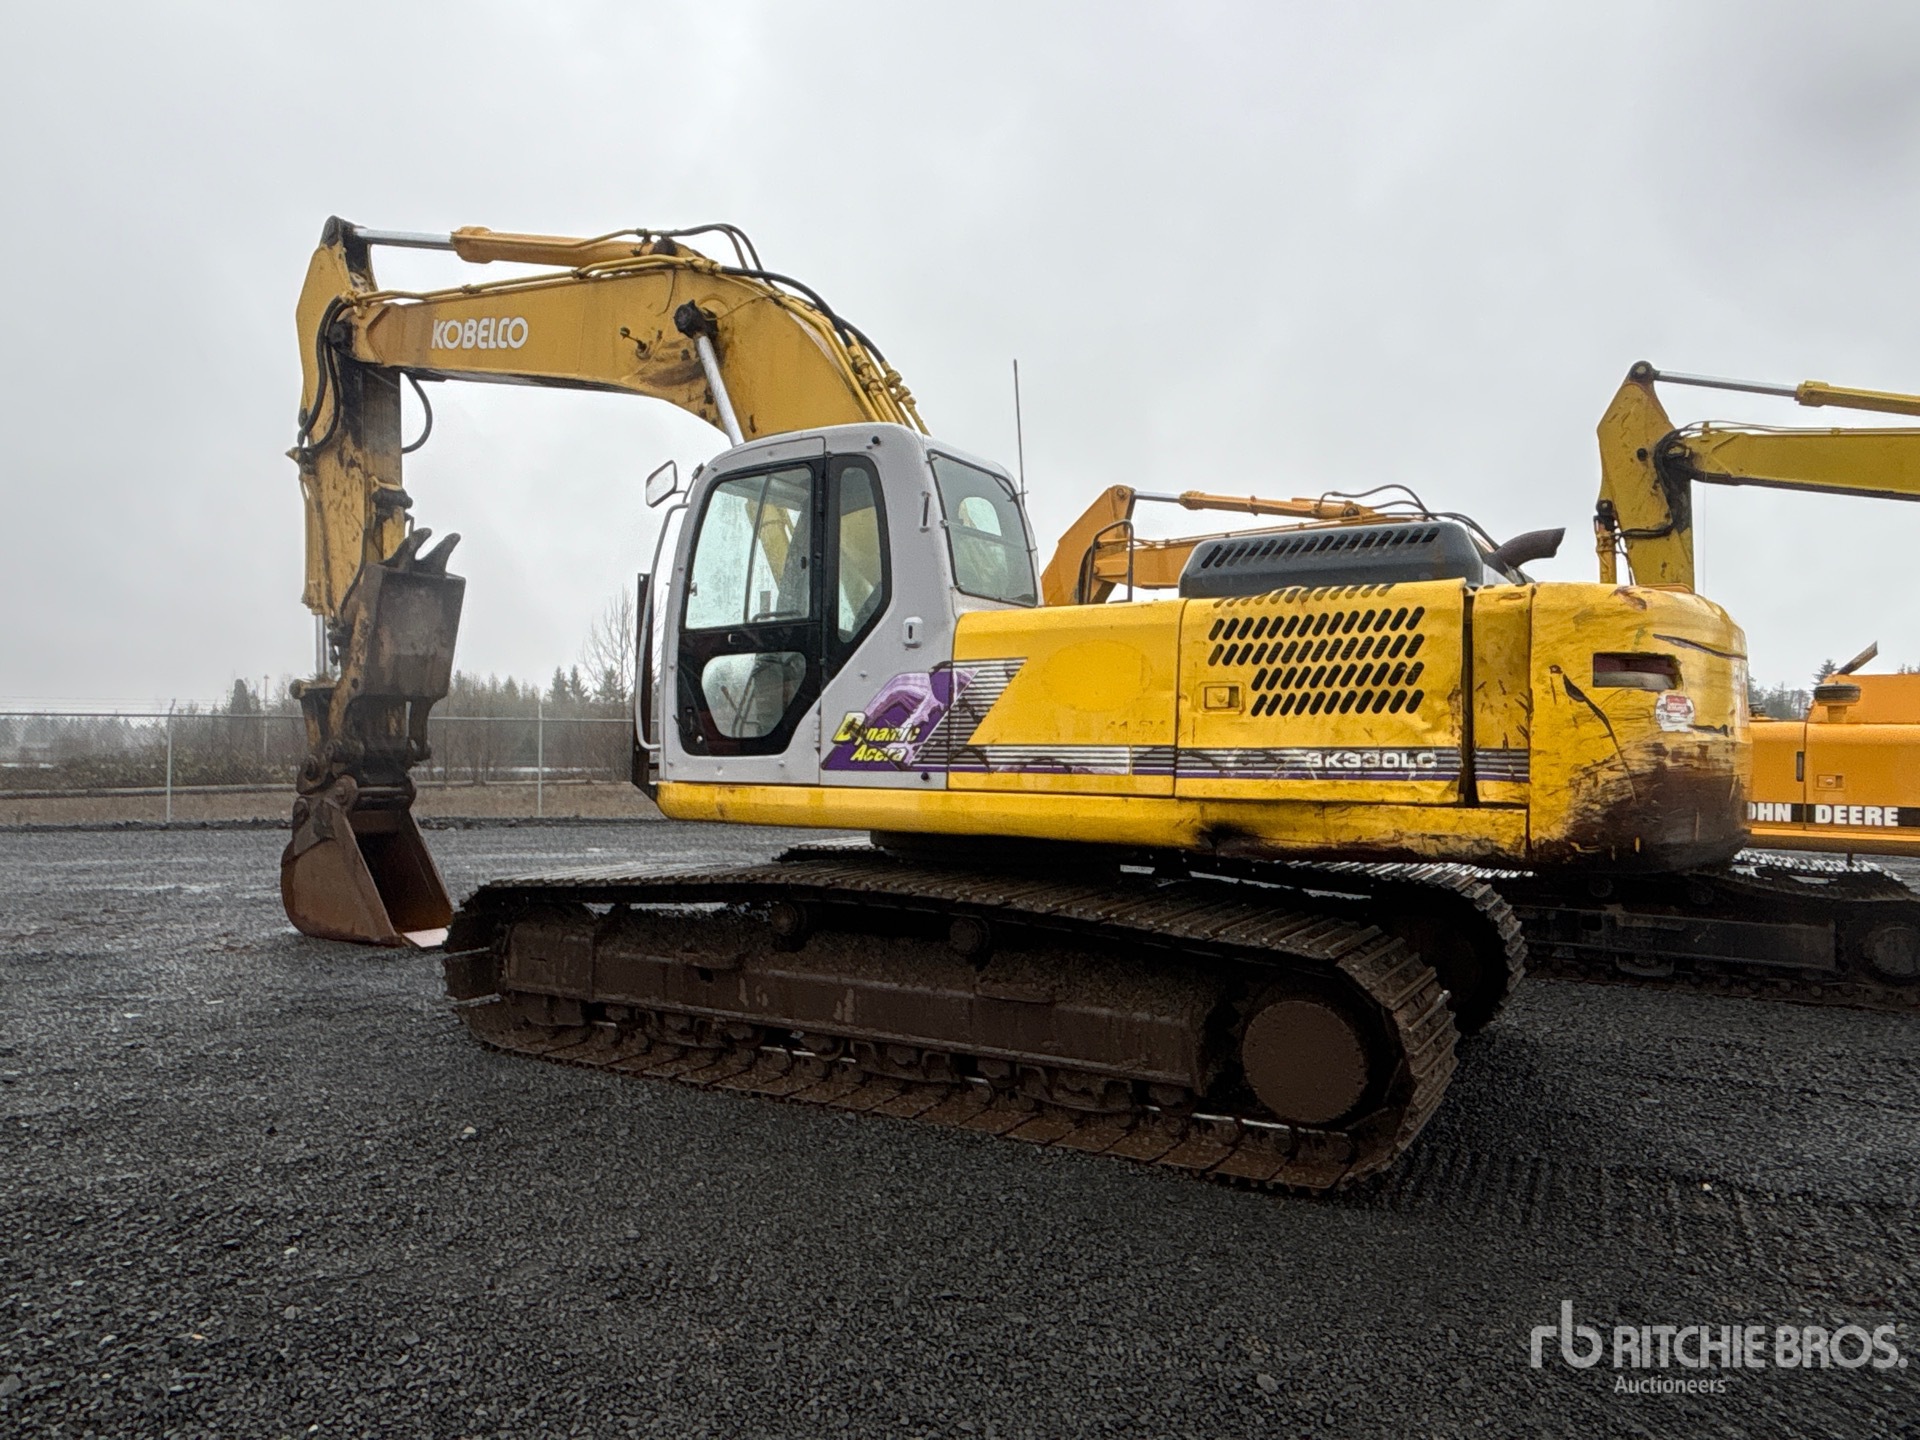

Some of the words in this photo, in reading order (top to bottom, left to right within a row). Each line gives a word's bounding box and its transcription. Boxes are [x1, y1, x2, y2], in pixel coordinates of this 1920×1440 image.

[431, 317, 529, 349] KOBELCO
[850, 744, 908, 762] Acera
[1747, 802, 1792, 823] OHN
[1815, 804, 1899, 827] DEERE
